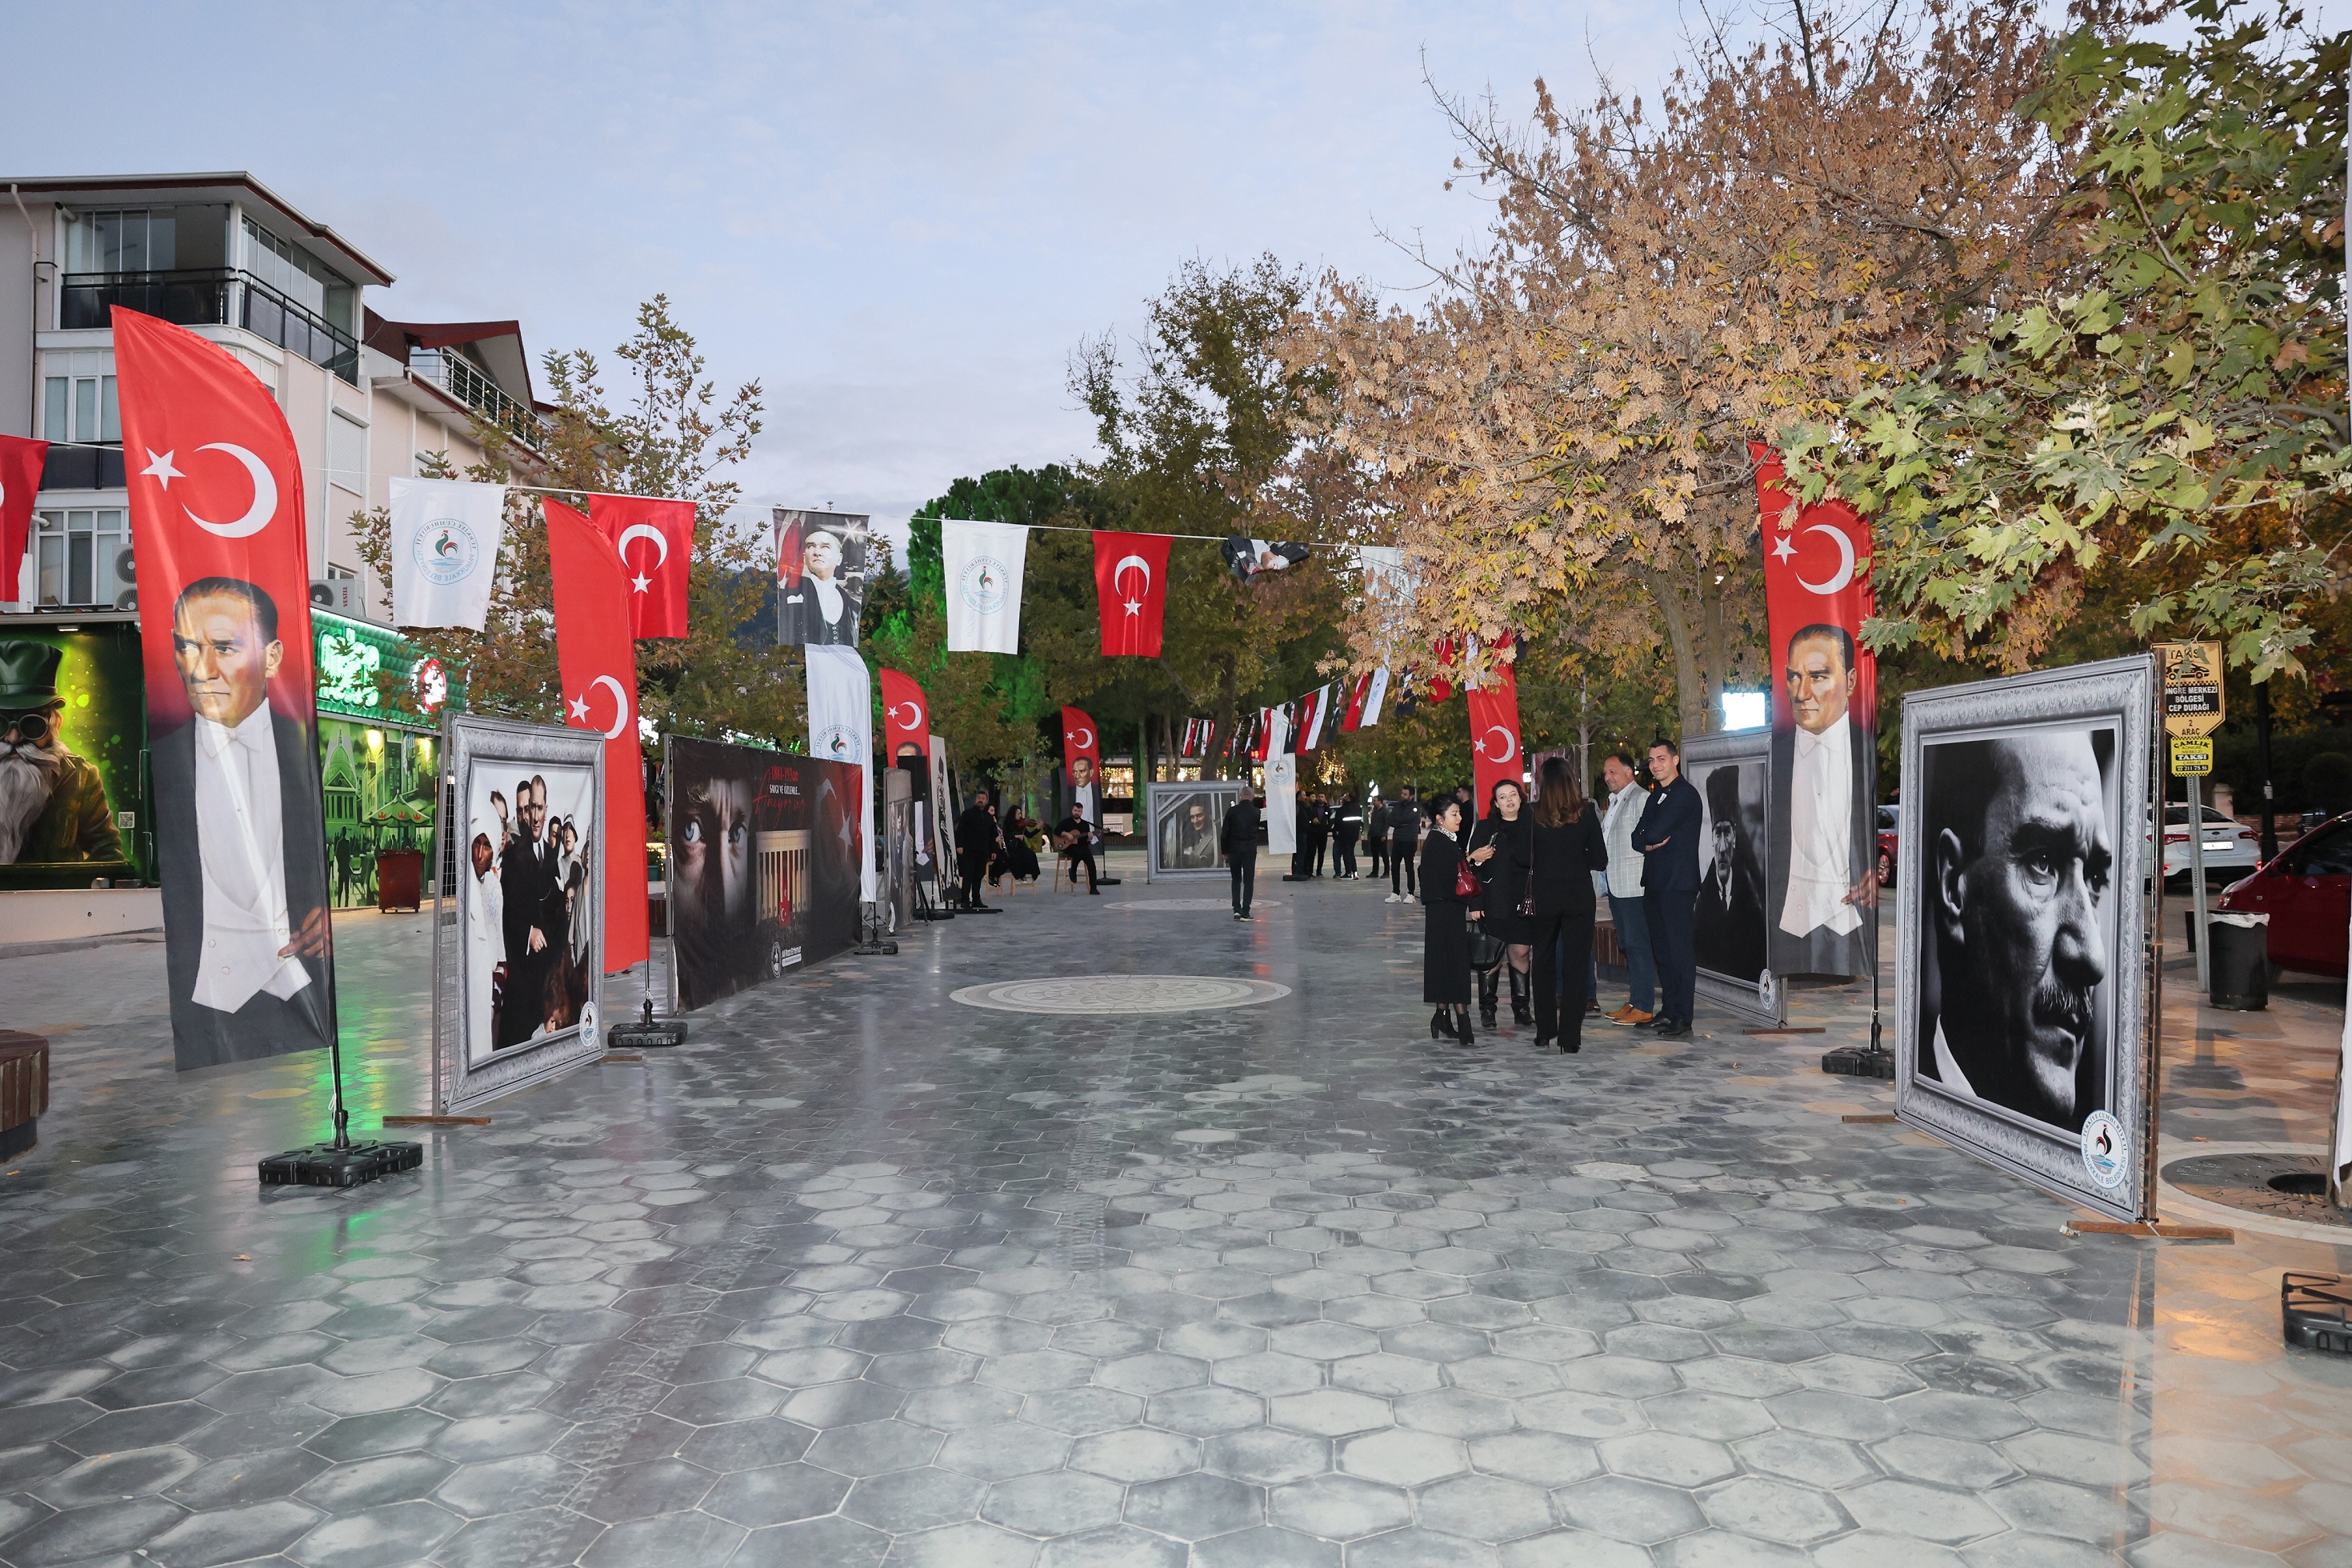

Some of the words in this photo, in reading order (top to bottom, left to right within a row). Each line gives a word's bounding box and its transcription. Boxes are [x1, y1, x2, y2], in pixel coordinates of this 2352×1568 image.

[2170, 647, 2201, 659] TAKS
[2188, 685, 2218, 694] MERKEZİ
[2175, 694, 2204, 702] BÖLGESİ
[2169, 704, 2182, 712] CEP
[2183, 702, 2210, 711] DURAĞI
[2182, 728, 2200, 736] ARAÇ
[2174, 741, 2210, 749] ÇAMLIK
[779, 785, 784, 794] VE
[2082, 1114, 2098, 1137] TÜRKİYE
[2098, 1112, 2128, 1151] CUMHURİYETİ
[2083, 1143, 2104, 1184] PAMUKKALE
[2106, 1156, 2127, 1185] BELEDİYESİ
